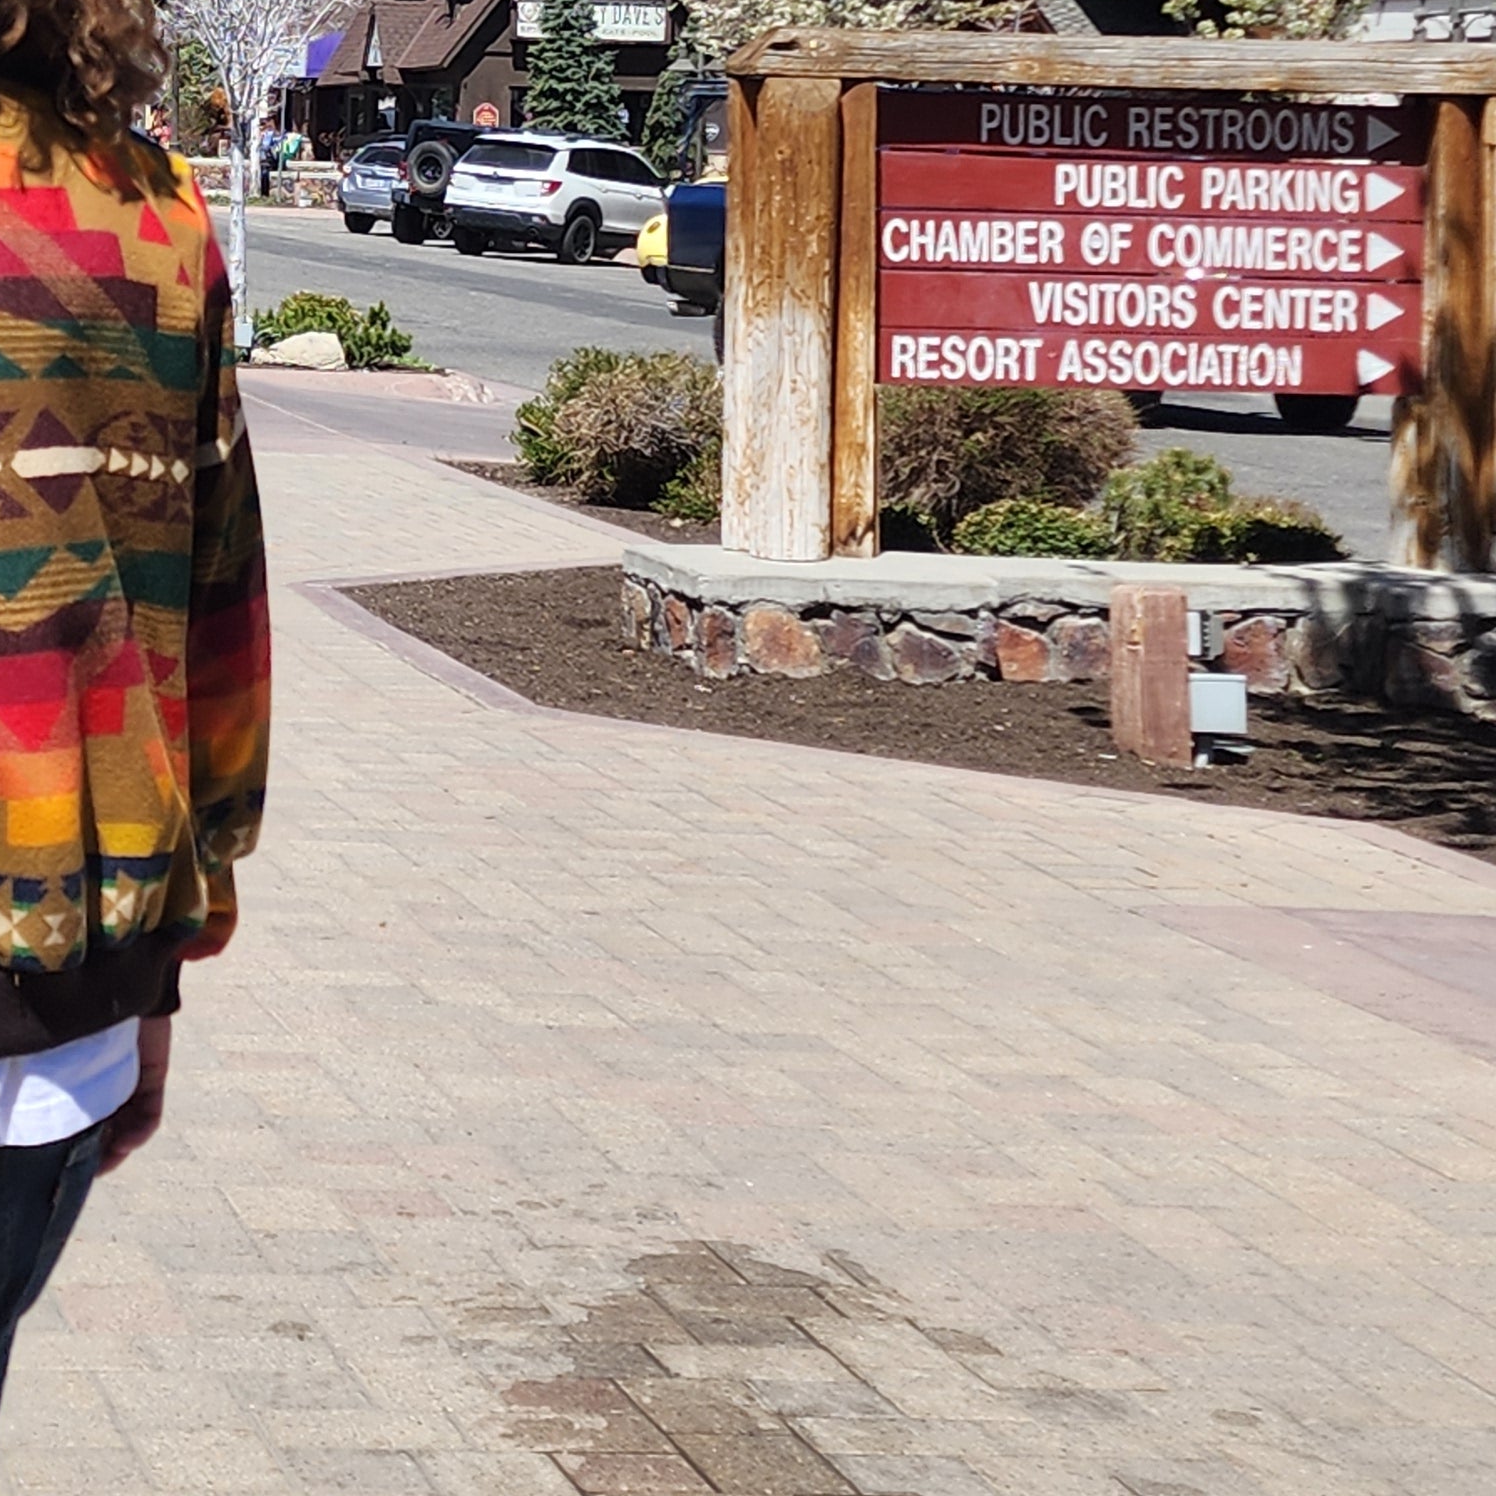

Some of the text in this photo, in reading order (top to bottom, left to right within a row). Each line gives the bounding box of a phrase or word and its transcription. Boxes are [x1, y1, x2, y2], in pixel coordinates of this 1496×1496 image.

[613, 2, 664, 26] DAVES
[979, 104, 1354, 154] PUBLIC RESTROOMS
[1055, 164, 1360, 213] PUBLIC PARKING
[882, 218, 1362, 272] CHAMBER OF COMMERCE
[1028, 281, 1358, 332] VISITORS CENTER
[891, 335, 1302, 386] RESORT ASSOCIATION
